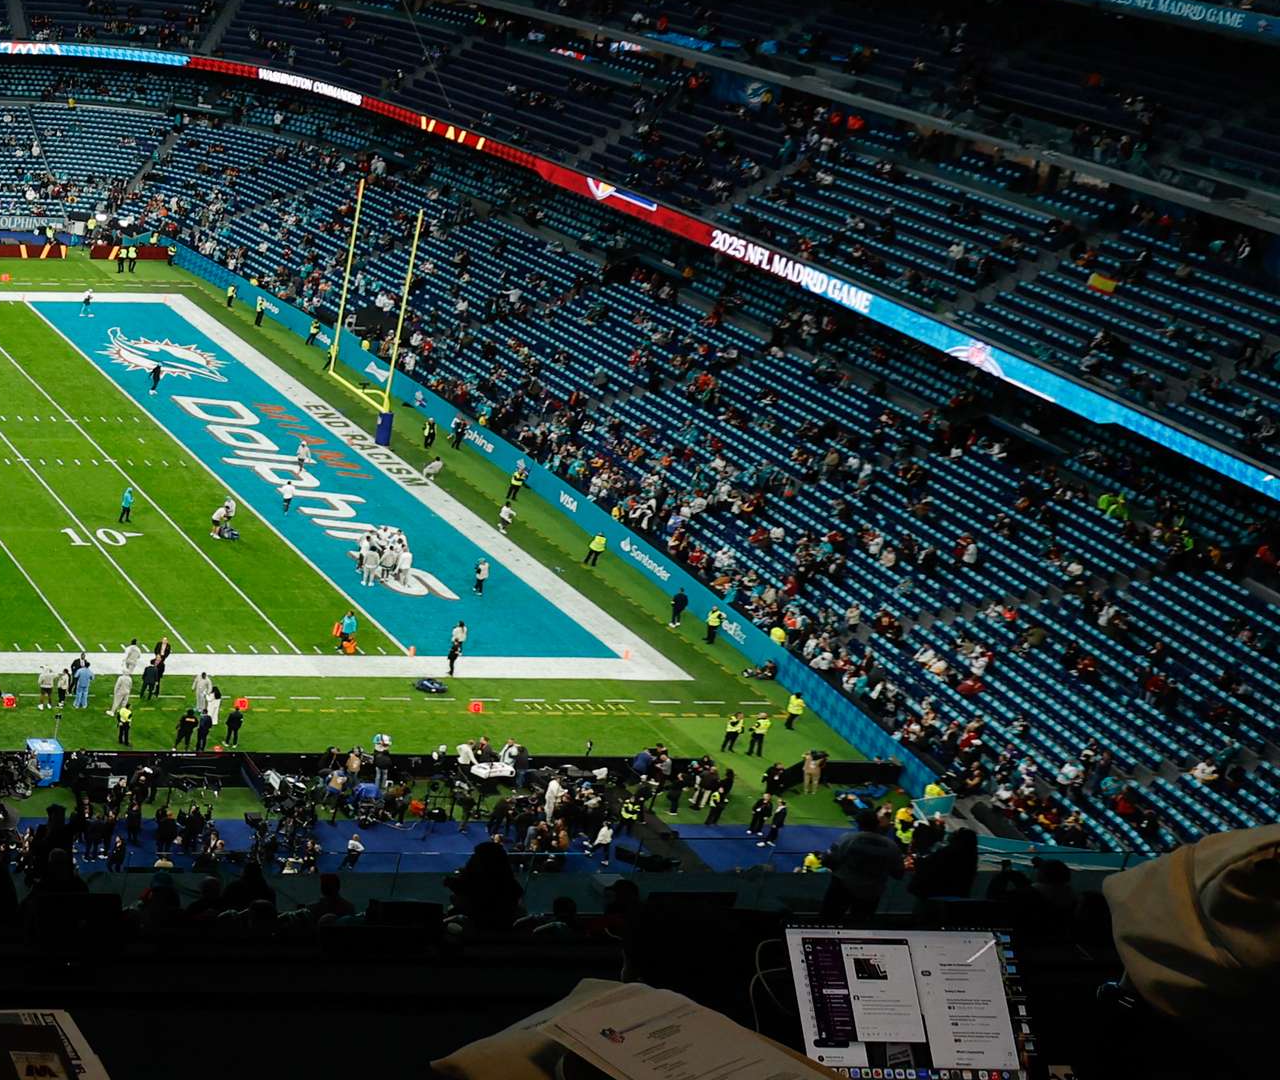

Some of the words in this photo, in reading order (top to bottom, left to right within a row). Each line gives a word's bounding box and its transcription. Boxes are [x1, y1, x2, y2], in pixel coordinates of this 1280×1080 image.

[1158, 0, 1206, 20] MADRID
[1206, 7, 1245, 28] GAME
[259, 68, 313, 92] WASHINGTON
[710, 229, 745, 258] 2025
[745, 244, 770, 271] NFL
[771, 254, 827, 293] MADRID
[826, 277, 873, 313] GAME
[253, 403, 373, 479] MIAMI
[303, 402, 351, 429] END
[344, 431, 431, 488] RACISM
[464, 429, 495, 454] phins
[560, 491, 578, 512] VISA
[62, 527, 132, 548] 10
[630, 544, 672, 582] Santander
